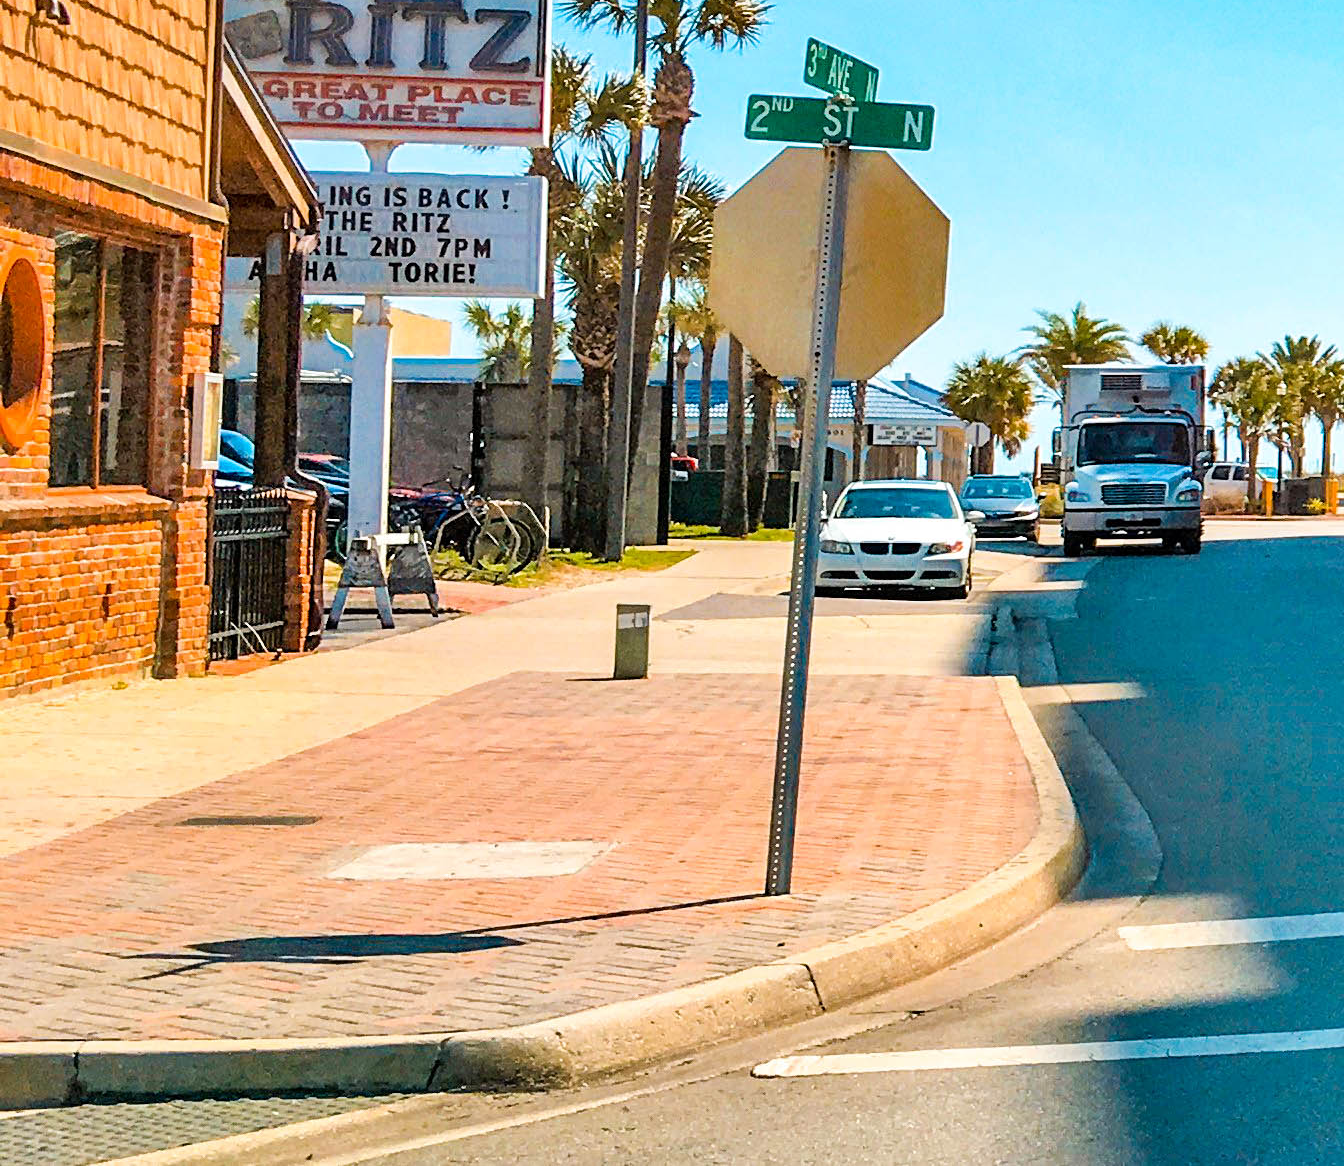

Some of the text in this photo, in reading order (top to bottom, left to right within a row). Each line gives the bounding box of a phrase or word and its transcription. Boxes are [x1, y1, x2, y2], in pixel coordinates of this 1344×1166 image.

[283, 0, 532, 73] RITZ
[827, 54, 854, 92] AVE
[864, 70, 876, 103] N
[262, 79, 535, 106] GREAT PLACE
[292, 101, 465, 124] TO MEET
[750, 97, 924, 143] 2ND ST N
[384, 187, 408, 208] IS
[417, 188, 489, 209] BACK
[325, 210, 451, 234] THE RITZ
[369, 236, 417, 258] 2ND
[437, 237, 492, 259] 7PM
[388, 262, 477, 285] TORIE!
